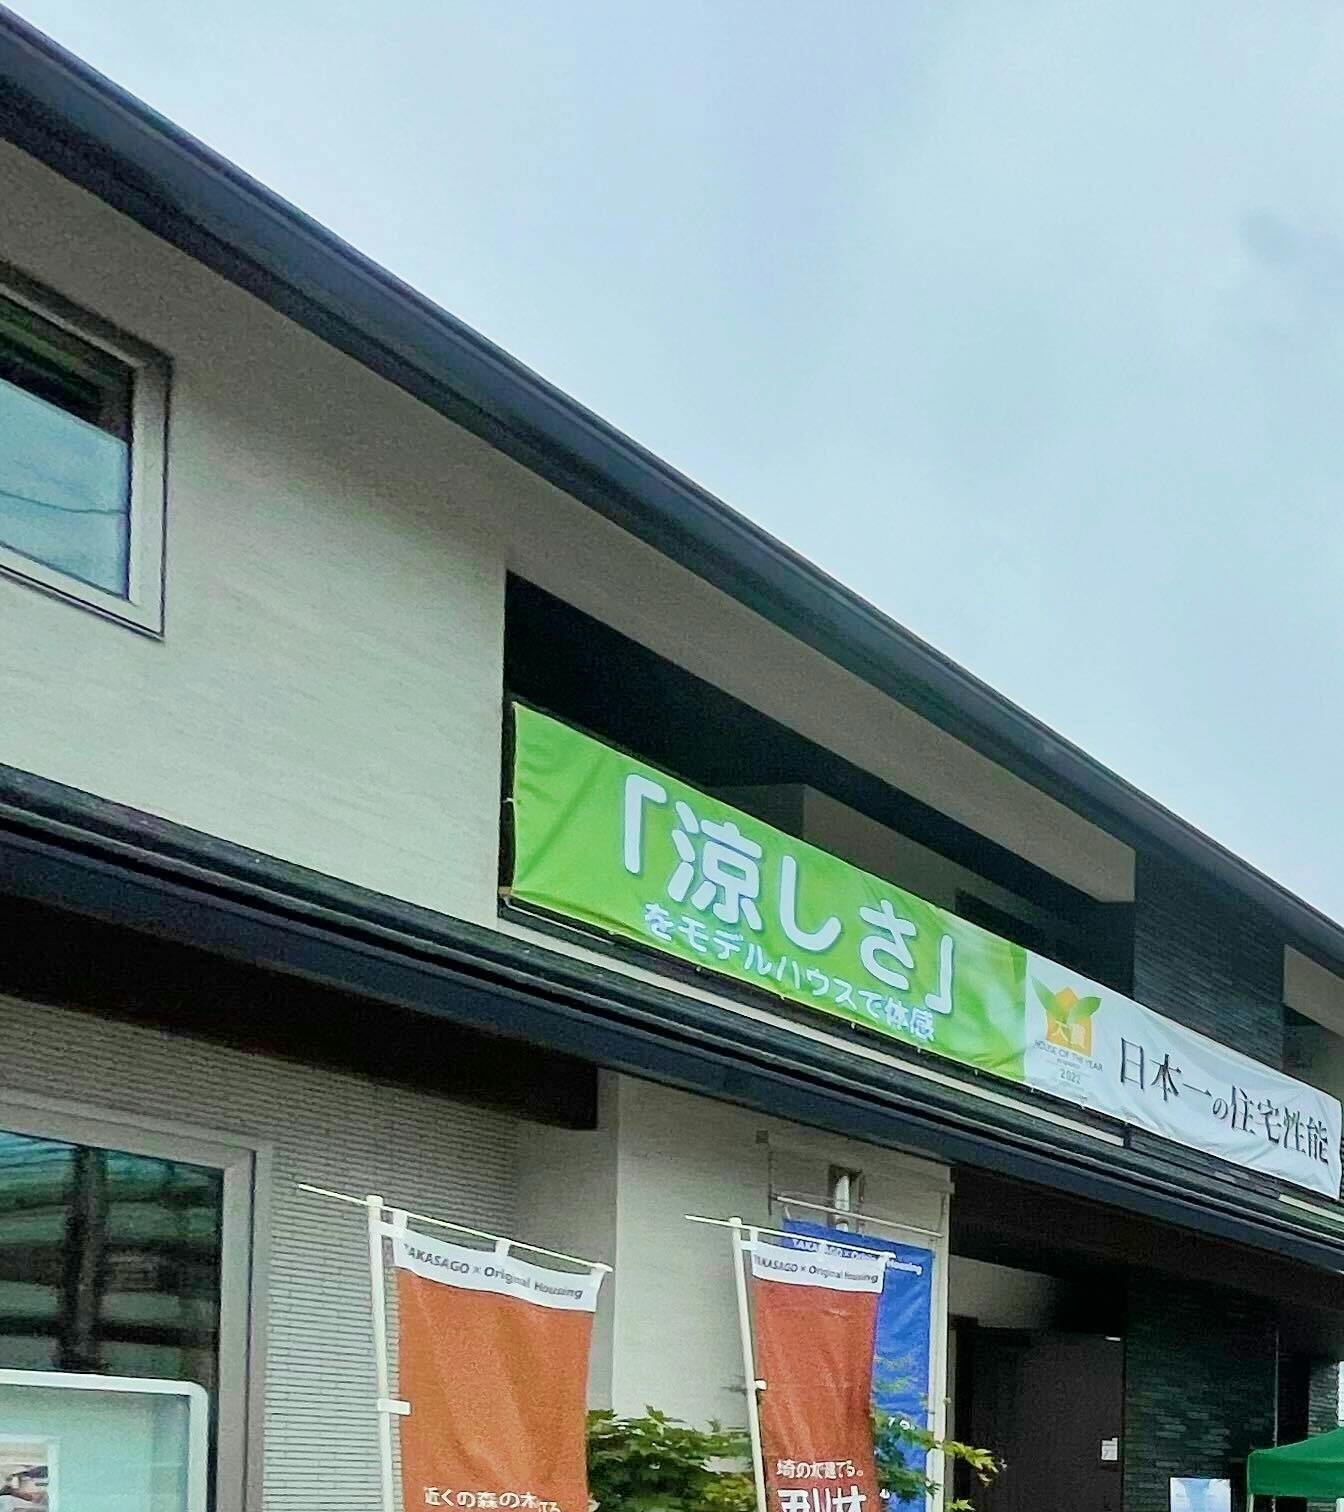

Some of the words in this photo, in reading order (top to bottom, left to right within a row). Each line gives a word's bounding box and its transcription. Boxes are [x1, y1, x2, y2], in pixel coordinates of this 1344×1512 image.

[643, 901, 937, 1042] をモデルハウスで体感
[1120, 1036, 1329, 1165] 日本一の住宅性能
[403, 1242, 470, 1274] AKASAGO
